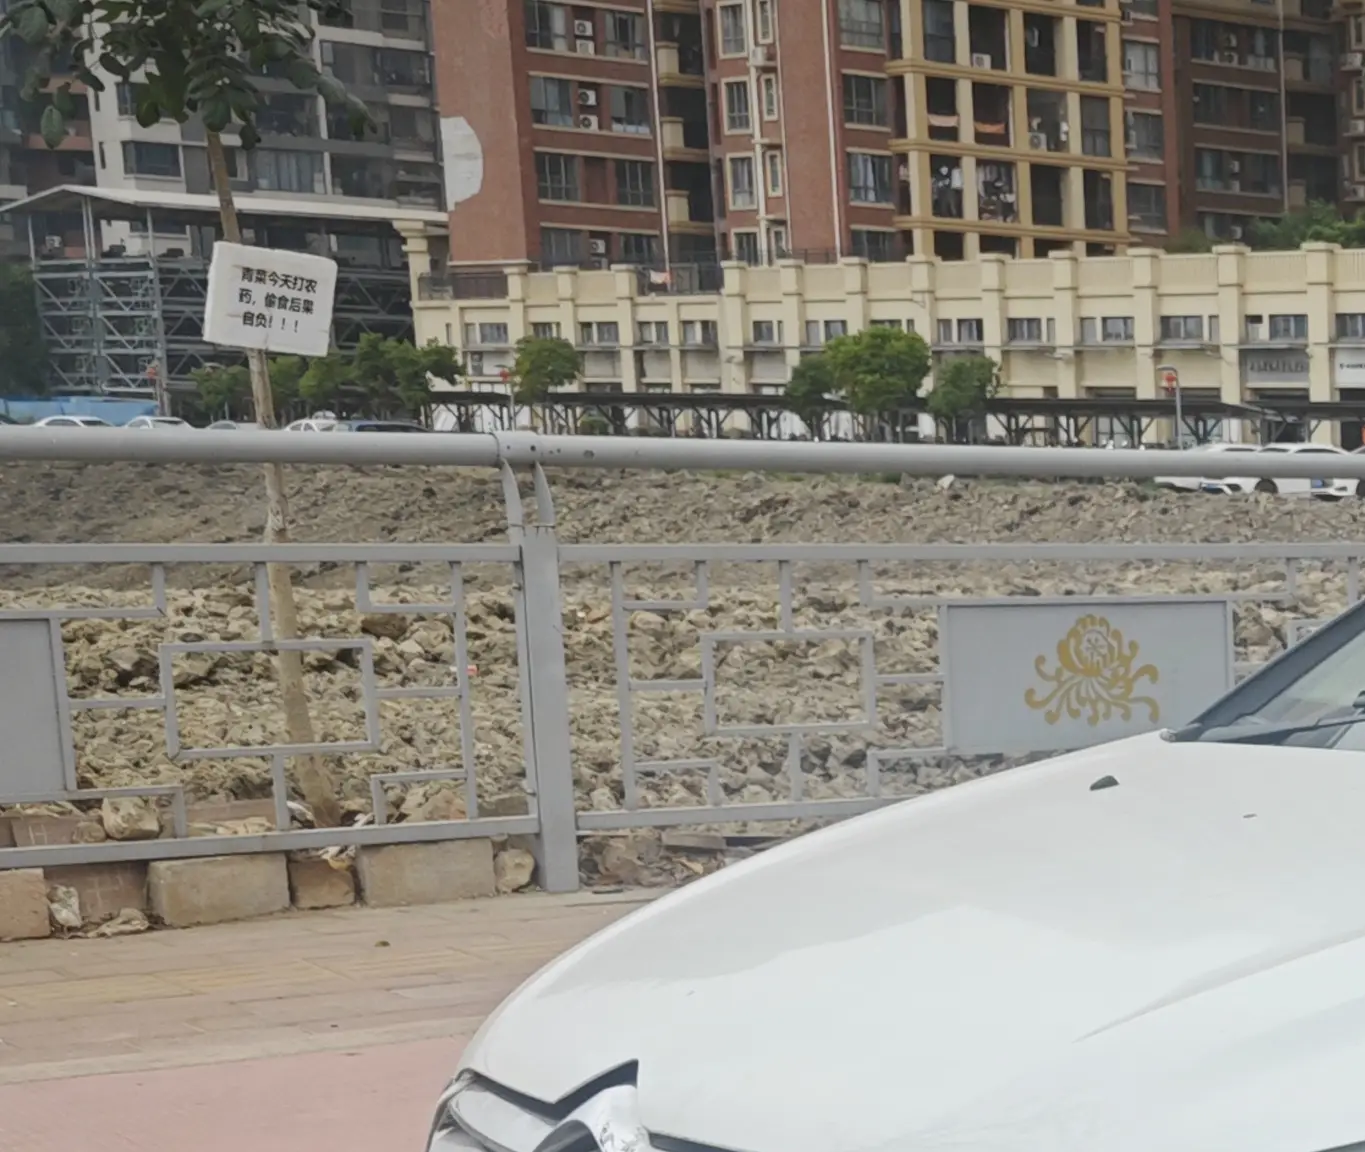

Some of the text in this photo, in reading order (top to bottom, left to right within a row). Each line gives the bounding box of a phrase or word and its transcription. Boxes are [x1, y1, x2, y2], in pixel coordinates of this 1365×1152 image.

[241, 266, 317, 293] 青菜今天打农
